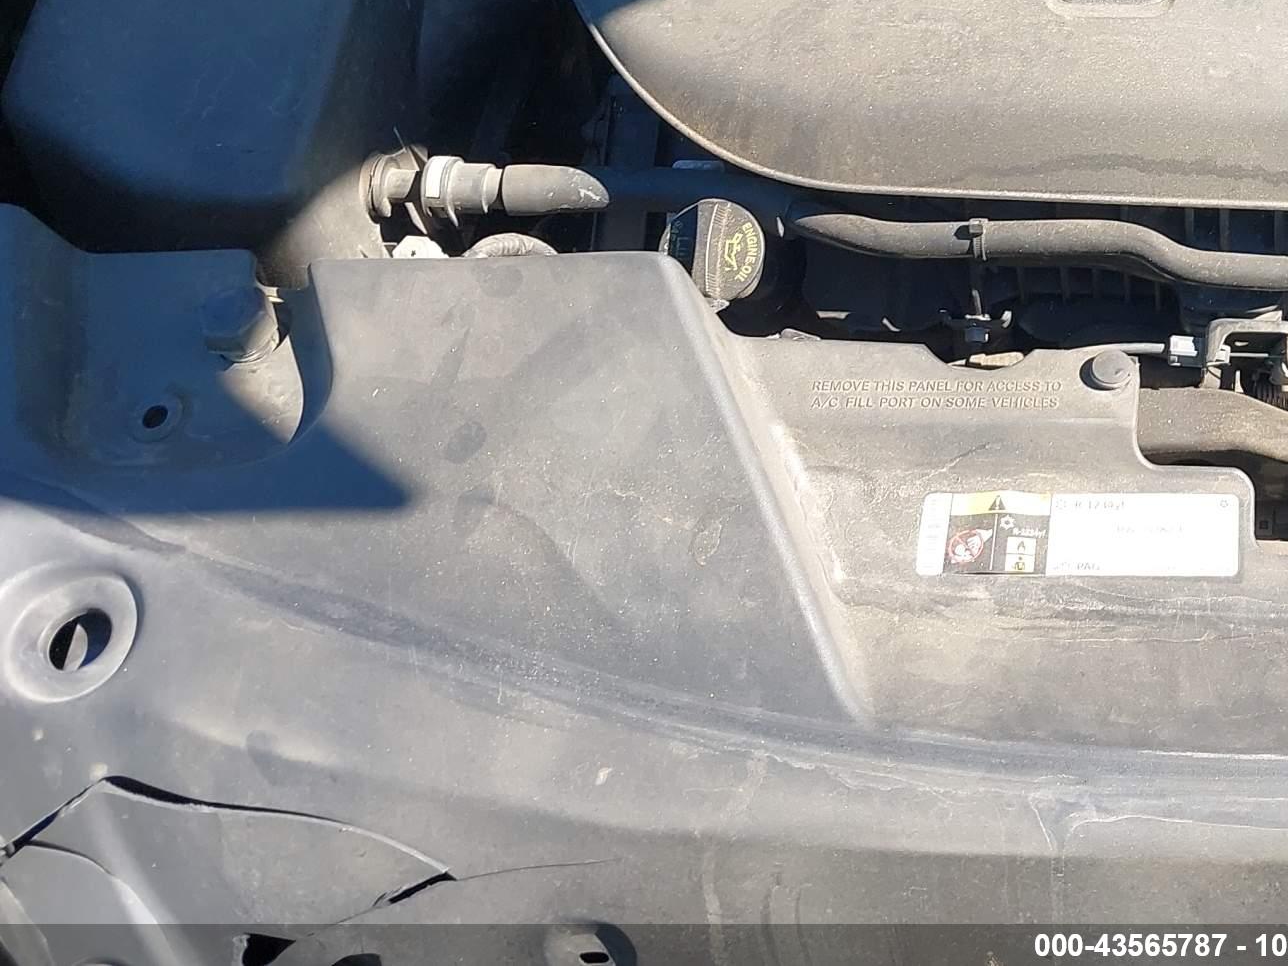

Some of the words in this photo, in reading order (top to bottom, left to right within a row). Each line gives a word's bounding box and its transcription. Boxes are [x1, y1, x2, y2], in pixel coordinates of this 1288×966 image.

[742, 221, 758, 265] ENGINE
[734, 265, 752, 282] OIL
[812, 380, 870, 392] REMOVE
[873, 380, 904, 392] THIS
[908, 380, 952, 392] PANEL
[956, 380, 983, 392] FOR
[986, 380, 1040, 392] ACCESS
[1044, 380, 1062, 392] TO
[811, 396, 839, 409] A/C
[845, 396, 873, 408] FILL
[879, 396, 915, 408] PORT
[920, 396, 942, 408] ON
[945, 396, 986, 408] SOME
[991, 396, 1058, 409] VEHICLES
